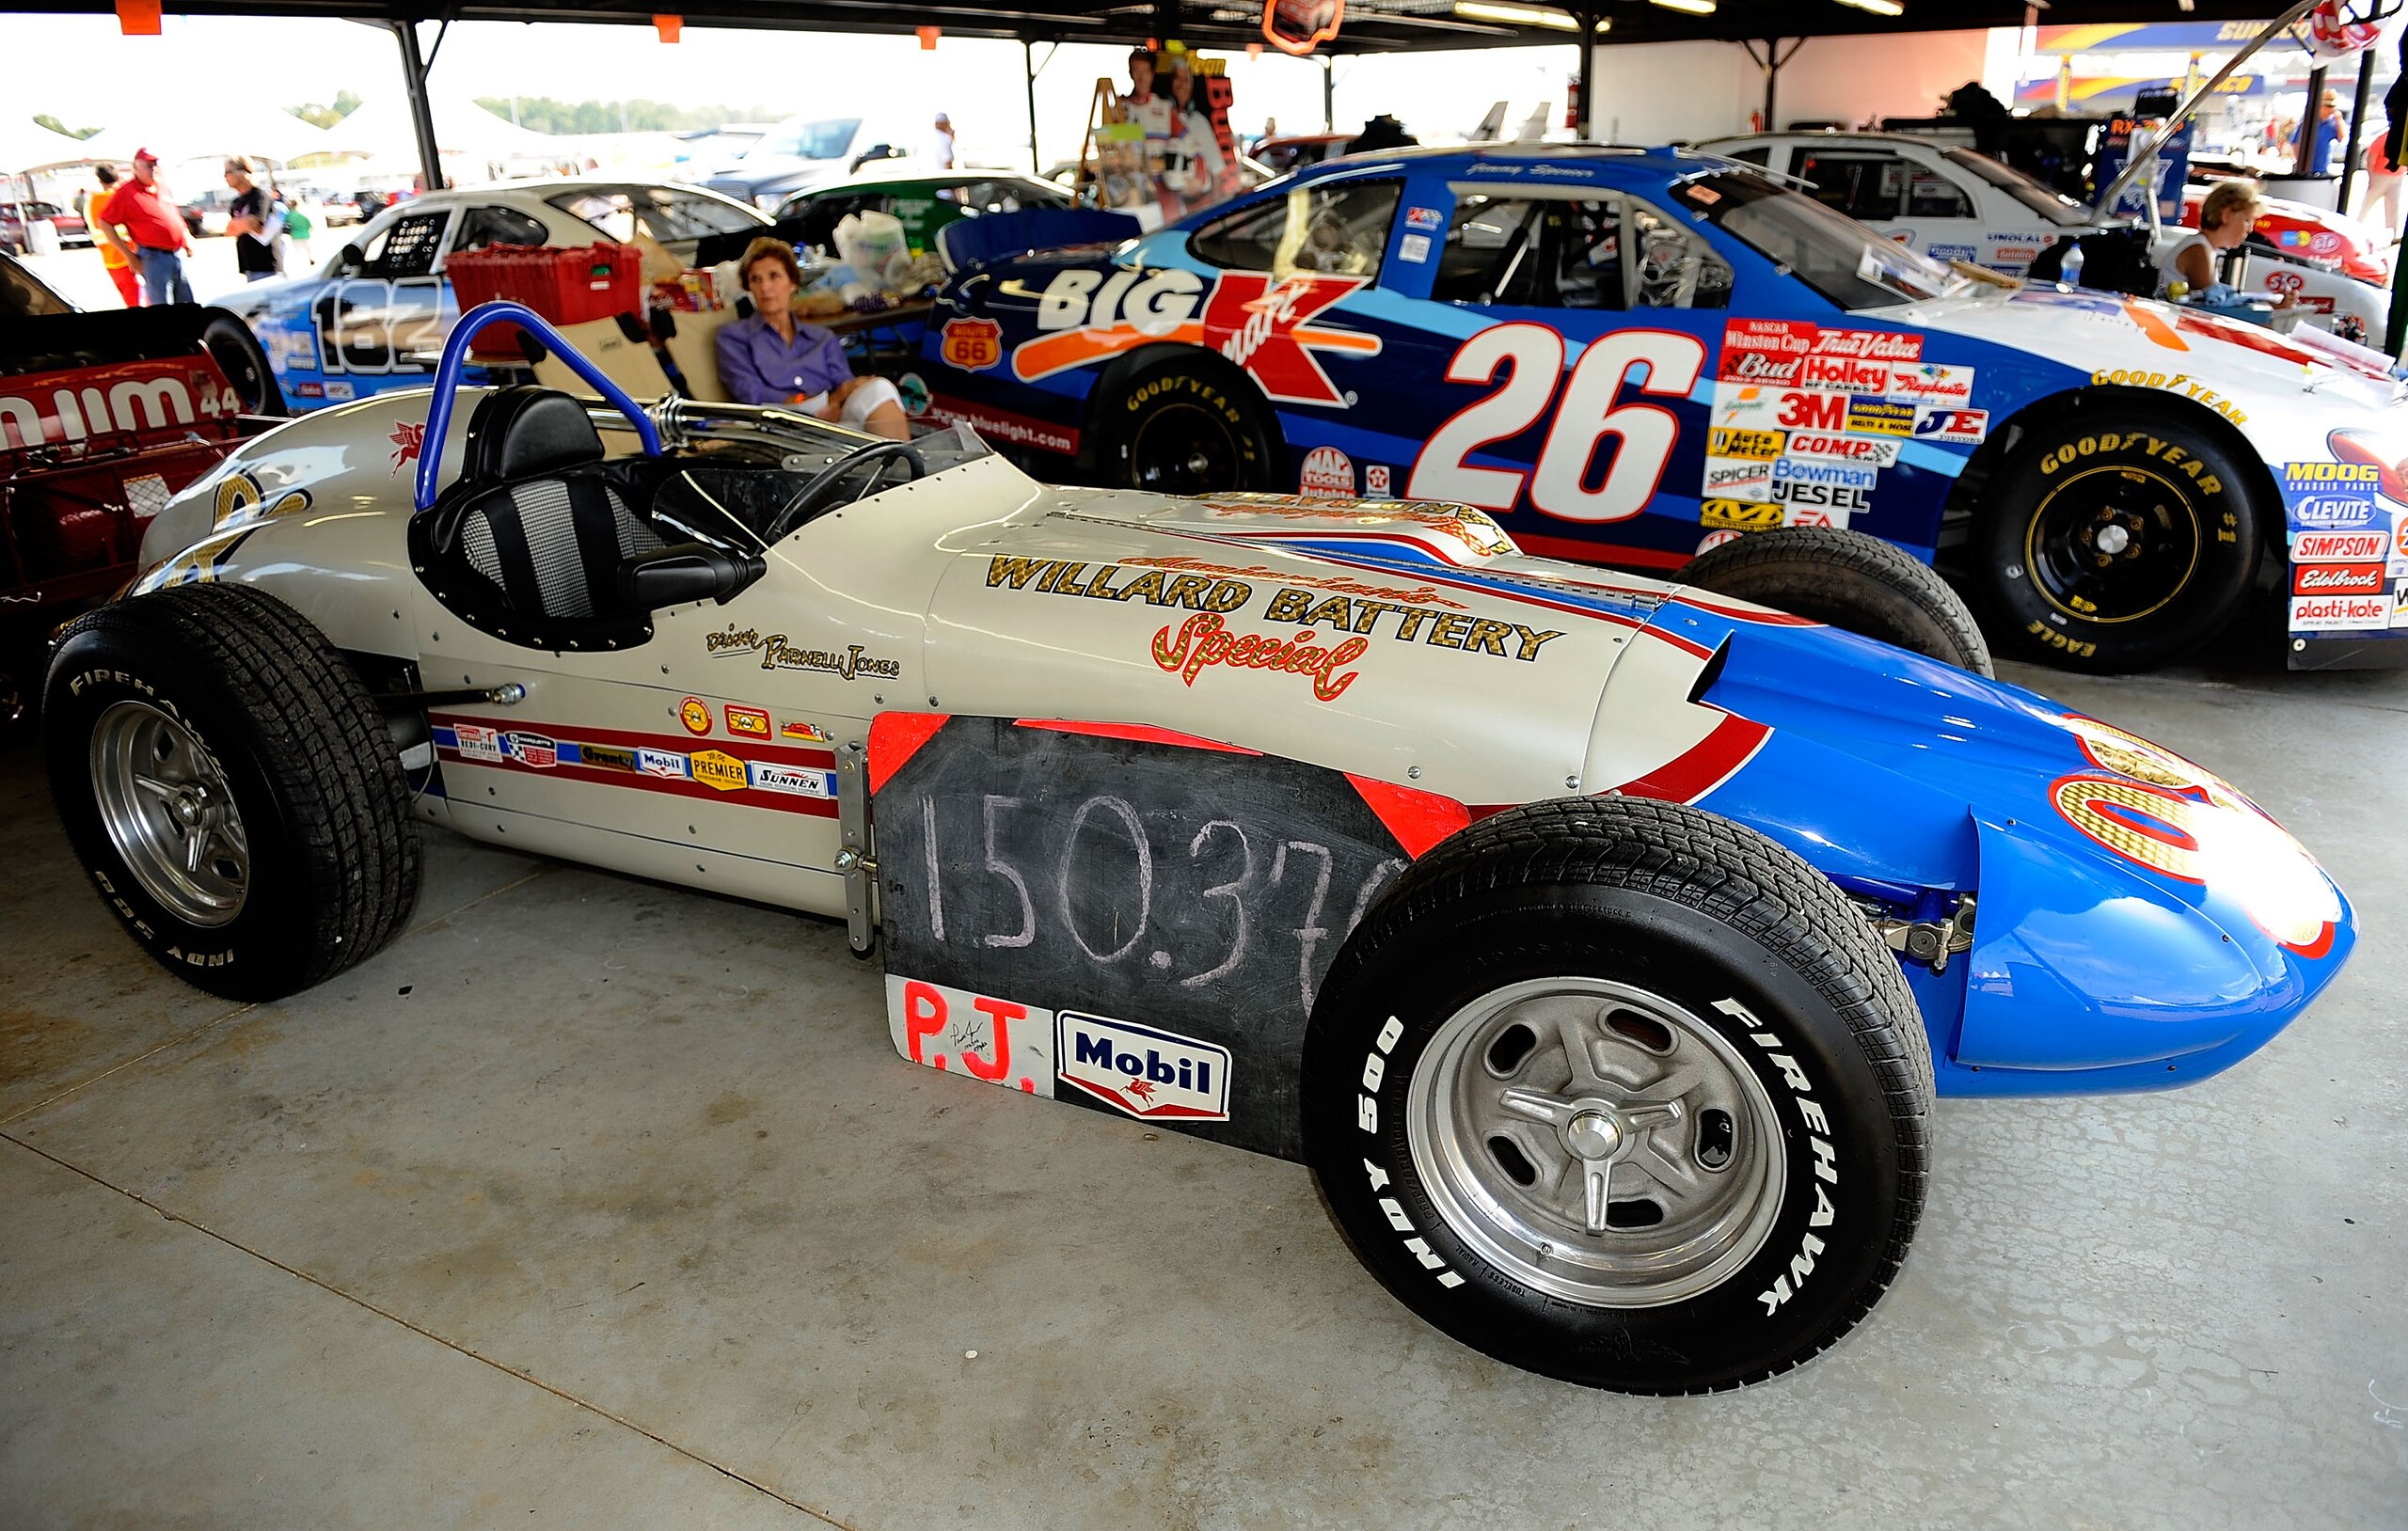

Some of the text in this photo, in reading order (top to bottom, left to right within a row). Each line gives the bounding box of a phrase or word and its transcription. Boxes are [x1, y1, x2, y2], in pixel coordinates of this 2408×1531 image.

[1038, 269, 1374, 408] BIG K
[1749, 322, 1790, 334] NASCAR
[956, 340, 988, 361] 66
[1725, 330, 1811, 355] Winston Cup
[1736, 352, 1804, 379] Bud
[1807, 358, 1889, 394] Holley
[200, 387, 241, 418] 44
[1128, 375, 1240, 423] GOODYEAR
[1778, 392, 1846, 431] 3M
[2091, 370, 2249, 427] GOODYEAR
[1405, 321, 1708, 524] 26
[1915, 410, 1985, 434] JE
[1728, 444, 1779, 458] Meter
[1732, 434, 1771, 446] Auto
[1792, 436, 1874, 458] COMP
[1710, 465, 1769, 485] SPICER
[1775, 458, 1876, 487] Bowman
[2040, 432, 2223, 497] GOODYEAR
[2285, 463, 2379, 481] MOOG
[1773, 480, 1867, 510] JESEL
[2289, 481, 2379, 492] CHASSIS PARTS
[2297, 495, 2370, 520] CLEVITE
[2299, 536, 2381, 557] SIMPSON
[2299, 567, 2378, 588] Edelbrock
[985, 553, 1569, 664] WILLARD BATTERY
[2295, 600, 2384, 620] plasti-kote
[2027, 619, 2099, 657] EAGLE
[1151, 612, 1370, 702] Special
[644, 754, 680, 769] Mobil
[693, 759, 744, 781] PREMIER
[760, 769, 819, 790] SUNNEN
[166, 947, 234, 968] INDY
[1076, 1031, 1212, 1095] Mobil
[1358, 1015, 1404, 1135] 500
[1711, 997, 1839, 1318] FIREHAWK
[1364, 1158, 1467, 1291] INDY
[1455, 1243, 1527, 1298] RADIAL TUBELESS
